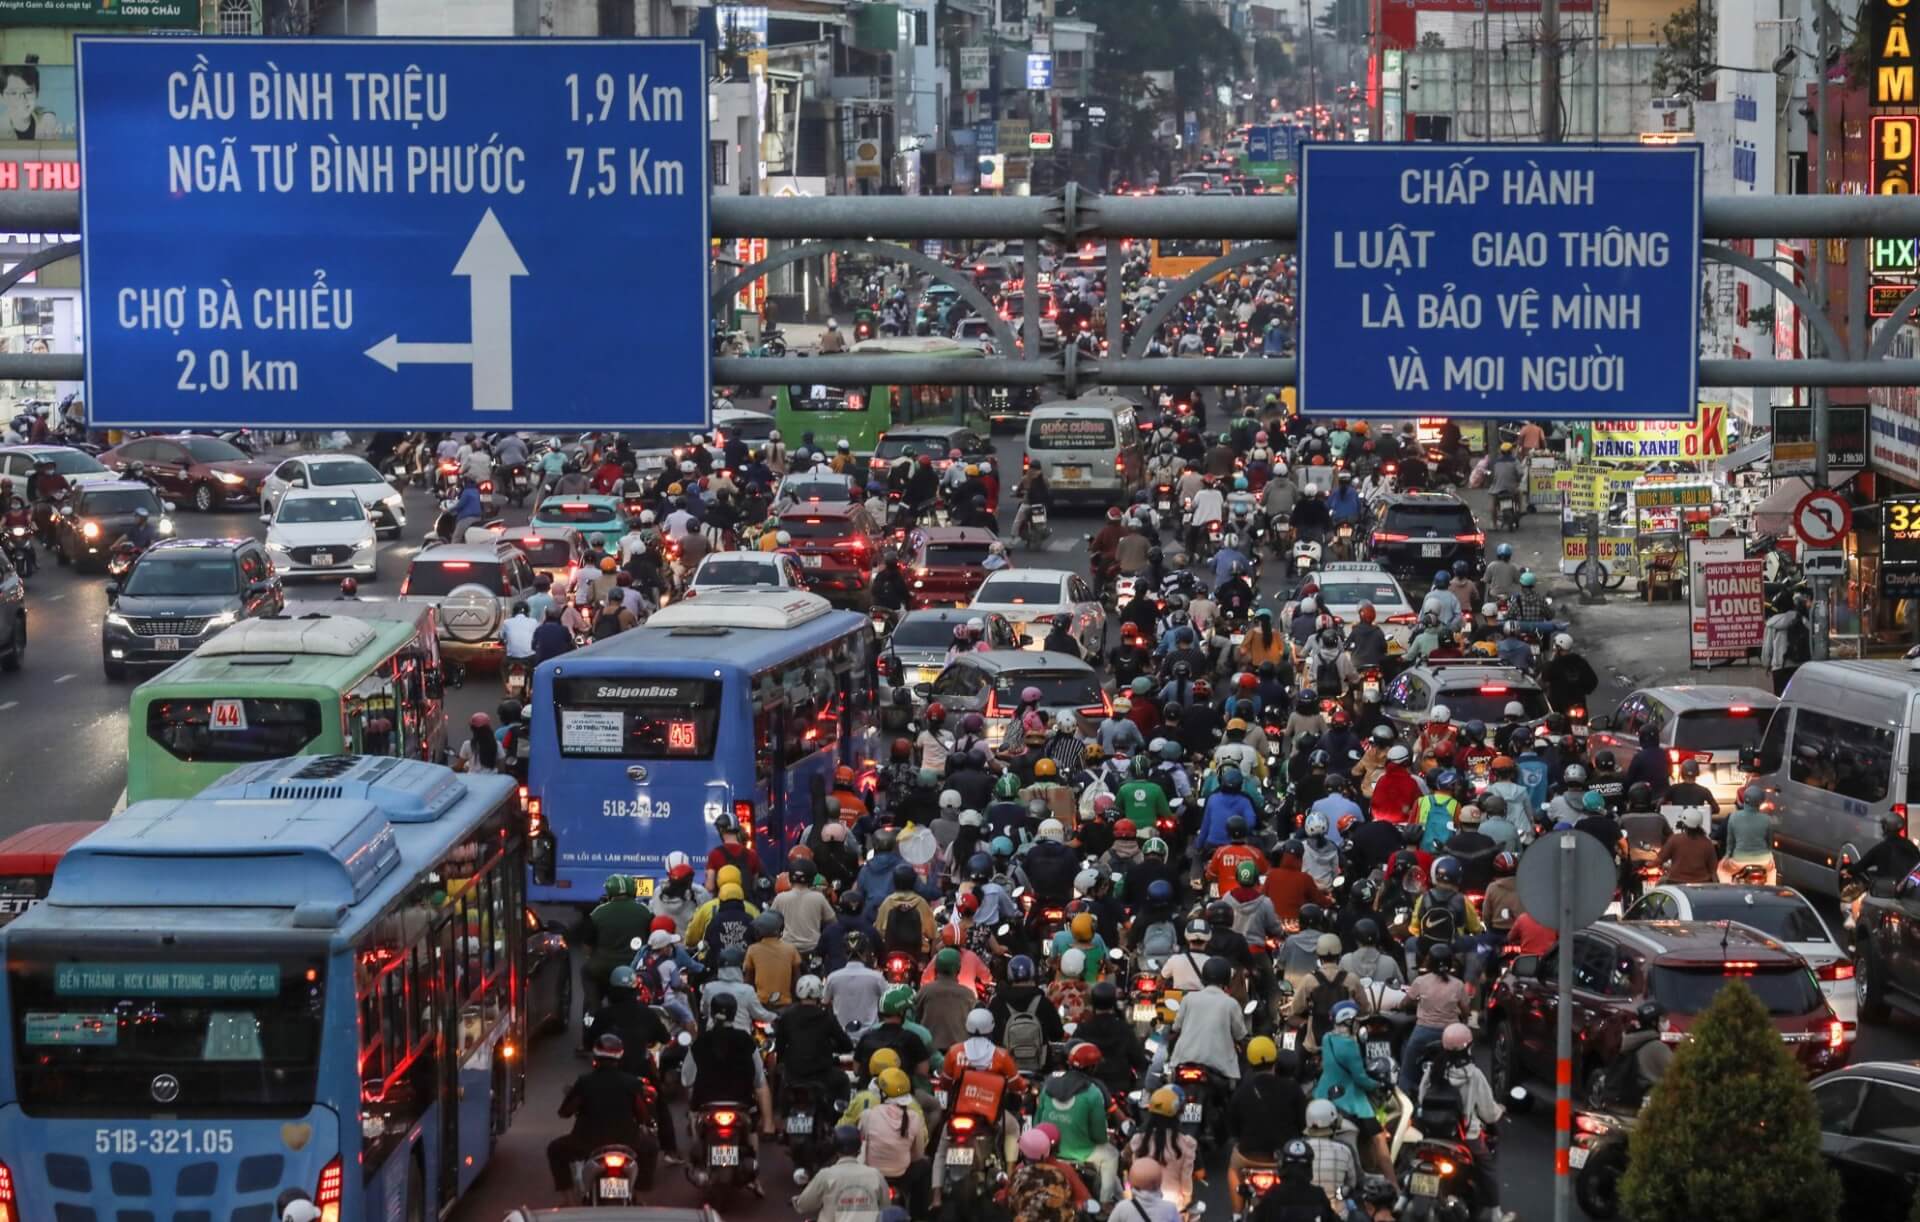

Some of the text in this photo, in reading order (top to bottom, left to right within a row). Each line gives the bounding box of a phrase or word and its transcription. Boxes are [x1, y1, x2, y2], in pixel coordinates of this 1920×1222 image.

[121, 6, 149, 15] LONG
[151, 4, 181, 15] CHÂU
[168, 54, 683, 129] CẦU BÌNH TRIỆU 1,9 Km
[169, 133, 683, 198] NGÃ TƯ BÌNH PHƯỚC 7,5 Km
[1401, 158, 1594, 204] CHẤP HÀNH
[1334, 224, 1669, 275] LUẬT GIAO THÔNG
[1876, 240, 1914, 266] HX
[118, 270, 353, 335] CHỢ BÀ CHIỂU
[1362, 283, 1640, 336] LÀ BẢO VỆ MÌNH
[177, 350, 298, 393] 2,0 km
[1389, 344, 1624, 399] VÀ MỌI NGƯỜI
[1638, 440, 1680, 458] XANH
[1615, 543, 1632, 556] 30K
[1707, 575, 1761, 596] HOÀNG
[1709, 598, 1761, 617] LONG
[597, 686, 679, 698] SaigonBus
[216, 703, 240, 726] 44
[671, 724, 693, 746] 45
[60, 968, 80, 990] BẾN
[82, 969, 115, 990] THÀNH
[146, 973, 169, 990] LINH
[230, 969, 257, 991] QUỐC
[259, 973, 275, 990] GIA
[96, 1130, 233, 1153] 51B-321.05
